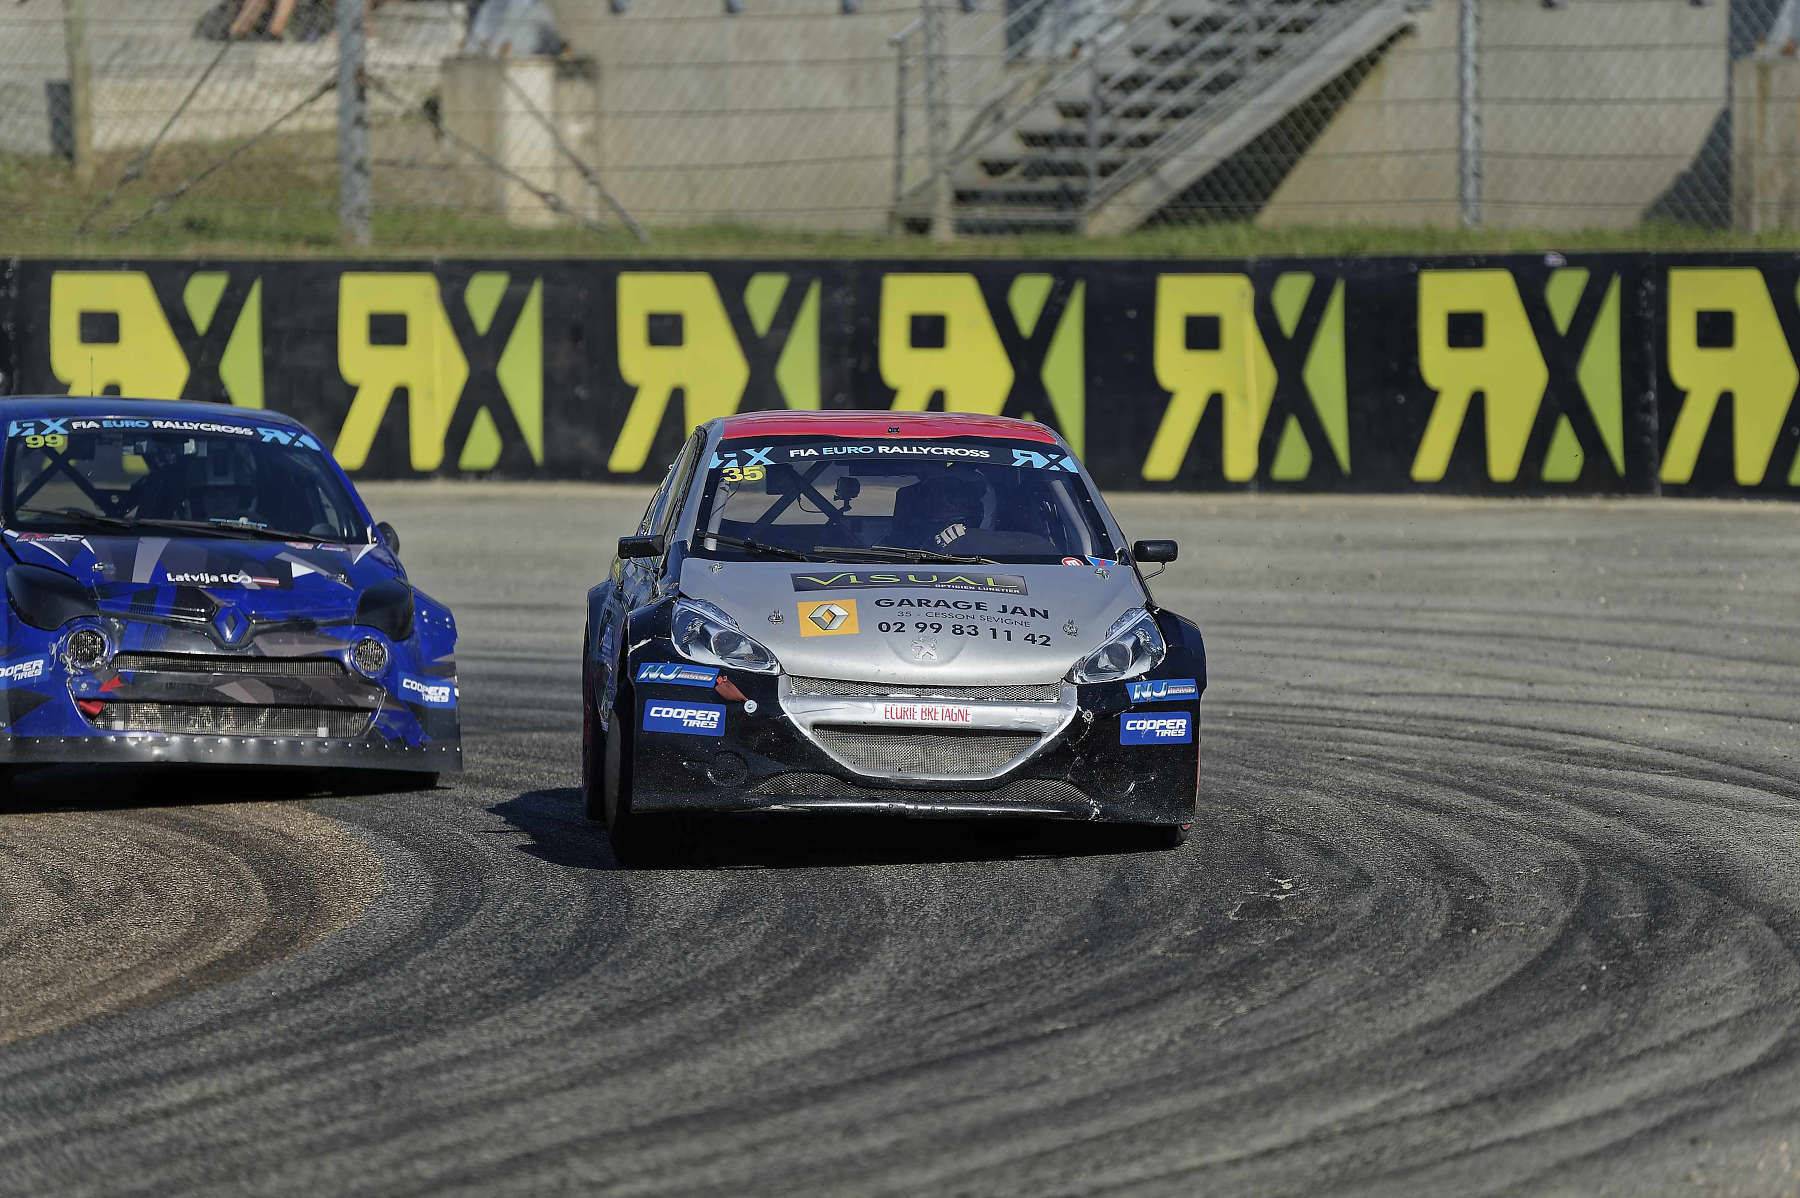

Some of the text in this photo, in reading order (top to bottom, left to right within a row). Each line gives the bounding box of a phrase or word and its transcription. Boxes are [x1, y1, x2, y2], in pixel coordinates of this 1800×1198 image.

[330, 271, 544, 472] RX
[1142, 271, 1351, 482] RX
[1410, 266, 1626, 483] RX
[71, 420, 100, 429] FIA
[102, 420, 149, 428] EURO
[152, 420, 253, 436] RALLYCROSS
[26, 435, 63, 448] 99
[789, 449, 819, 457] FIA
[823, 446, 874, 455] EURO
[878, 446, 990, 458] RALLYCROSS
[722, 466, 764, 482] 35
[166, 572, 218, 584] Latvija
[797, 572, 1018, 588] VISUAL
[875, 598, 1049, 620] GARAGE JAN
[925, 611, 975, 620] CESSON
[980, 614, 1030, 628] SEVIGNE
[877, 621, 1052, 647] 02 99 83 11 42
[403, 678, 450, 697] COOPER
[649, 706, 720, 721] COOPER
[884, 704, 971, 722] ECURIE BRETAGNE
[682, 719, 718, 729] TIRES
[1125, 719, 1187, 730] COOPER
[1155, 729, 1186, 737] TIRES
